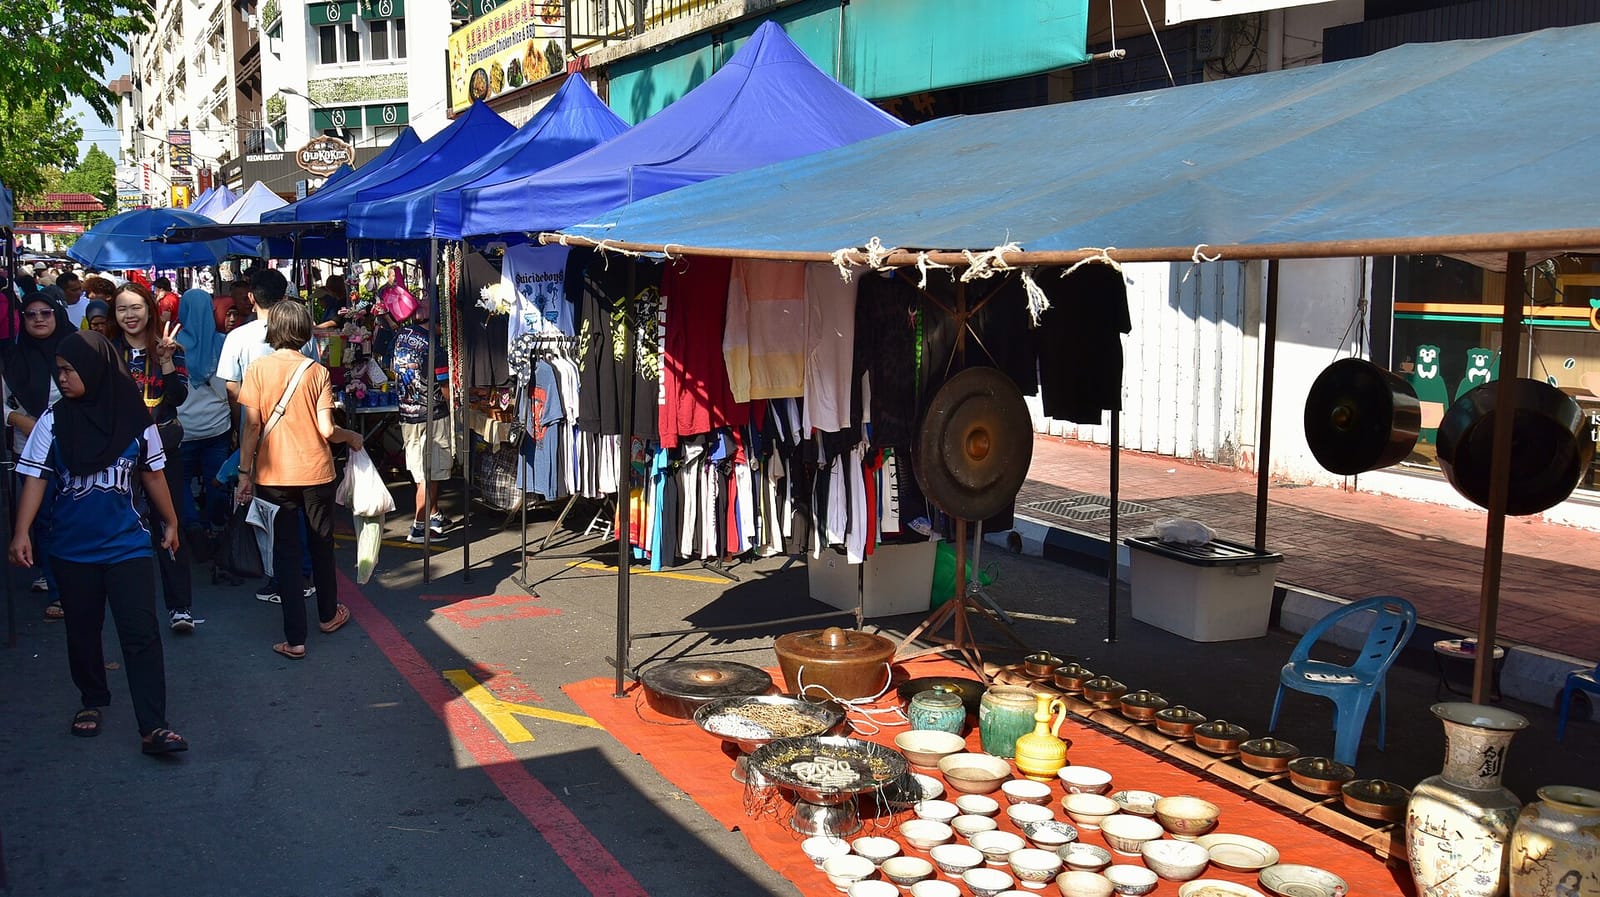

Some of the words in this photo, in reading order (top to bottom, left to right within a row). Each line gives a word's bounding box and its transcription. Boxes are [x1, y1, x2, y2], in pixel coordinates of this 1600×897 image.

[496, 36, 512, 53] Chicken
[512, 31, 522, 46] Rice
[526, 22, 536, 39] BBQ
